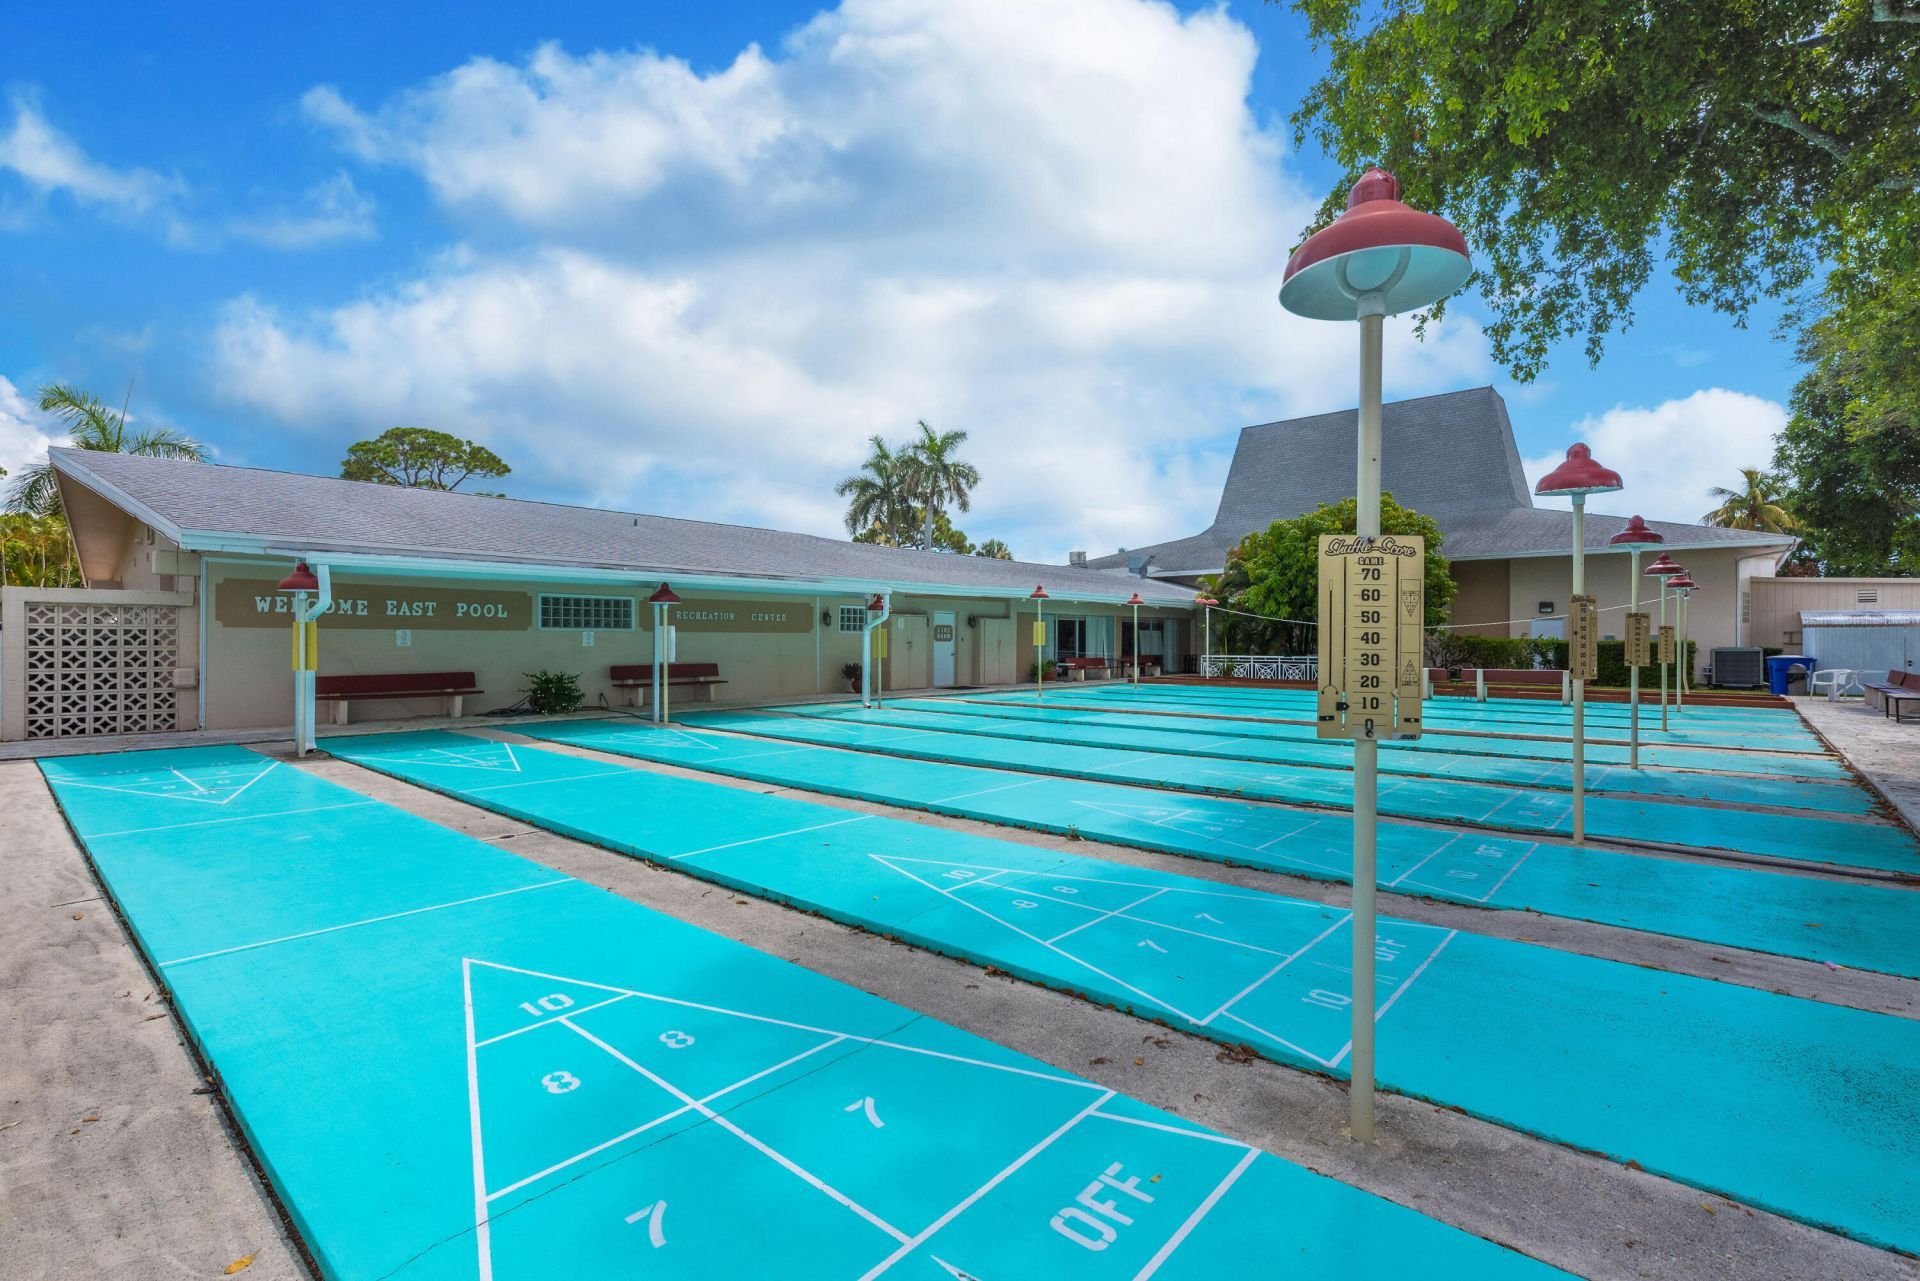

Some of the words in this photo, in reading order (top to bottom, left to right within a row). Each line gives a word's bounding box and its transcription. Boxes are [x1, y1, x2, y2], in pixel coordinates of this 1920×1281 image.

[1358, 557, 1384, 565] GAME
[1361, 568, 1380, 580] 70
[1361, 589, 1380, 601] 60
[386, 600, 437, 616] EAST
[456, 602, 508, 618] POOL
[676, 611, 735, 620] RECREATION
[751, 613, 787, 621] CENTER
[1361, 611, 1380, 623] 50
[1361, 632, 1380, 644] 40
[1360, 653, 1380, 666] 30
[1360, 675, 1380, 688] 20
[1361, 697, 1379, 709] 10
[1365, 719, 1374, 730] 0
[942, 869, 975, 880] 10
[1053, 885, 1078, 894] 8
[1011, 899, 1038, 909] 8
[1194, 912, 1224, 924] 7
[1137, 939, 1168, 953] 7
[519, 993, 575, 1016] 10
[1301, 989, 1352, 1010] 10
[659, 1030, 695, 1049] 8
[541, 1071, 581, 1094] 8
[844, 1096, 885, 1129] 7
[1050, 1161, 1155, 1252] OFF
[624, 1200, 667, 1248] 7
